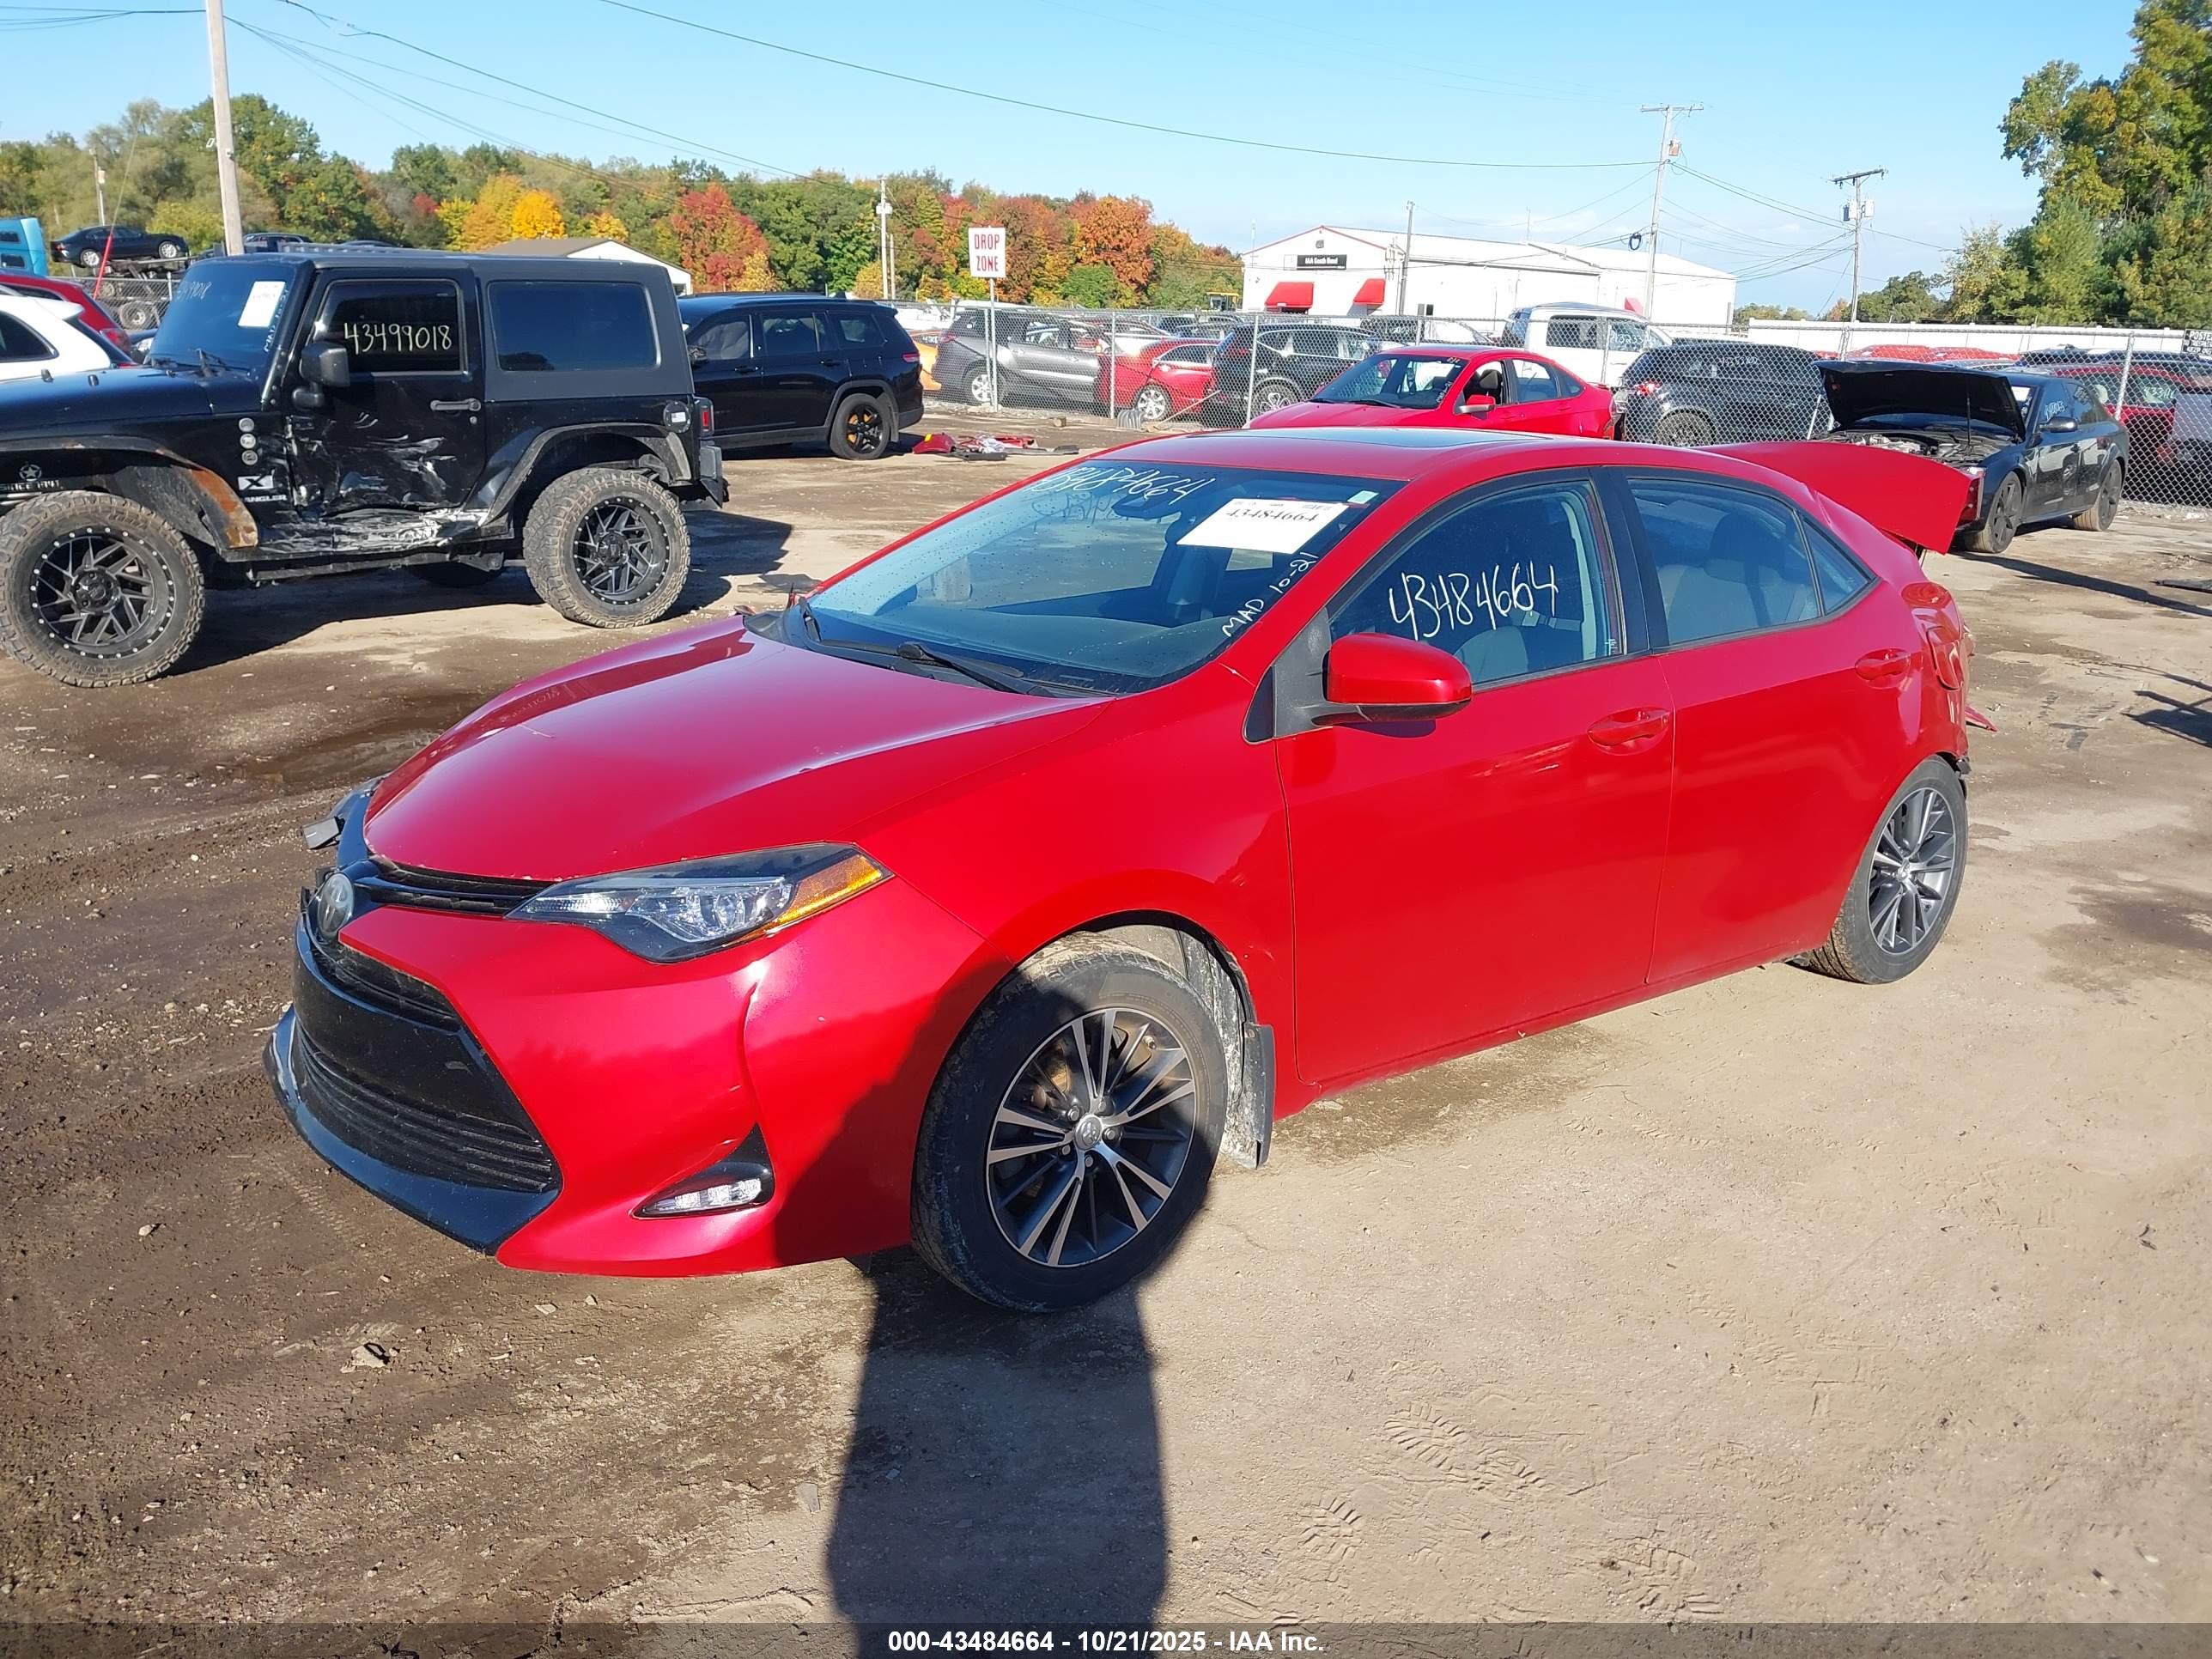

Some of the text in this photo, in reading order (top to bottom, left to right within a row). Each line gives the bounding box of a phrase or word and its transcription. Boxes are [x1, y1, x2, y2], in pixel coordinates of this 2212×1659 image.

[974, 234, 1000, 250] DROP
[975, 255, 999, 271] ZONE
[344, 323, 452, 355] 43499018
[2189, 330, 2212, 341] POSTE
[244, 494, 287, 502] ANGLER
[1222, 551, 1319, 637] MAD 10-21
[1389, 560, 1559, 641] 43484664
